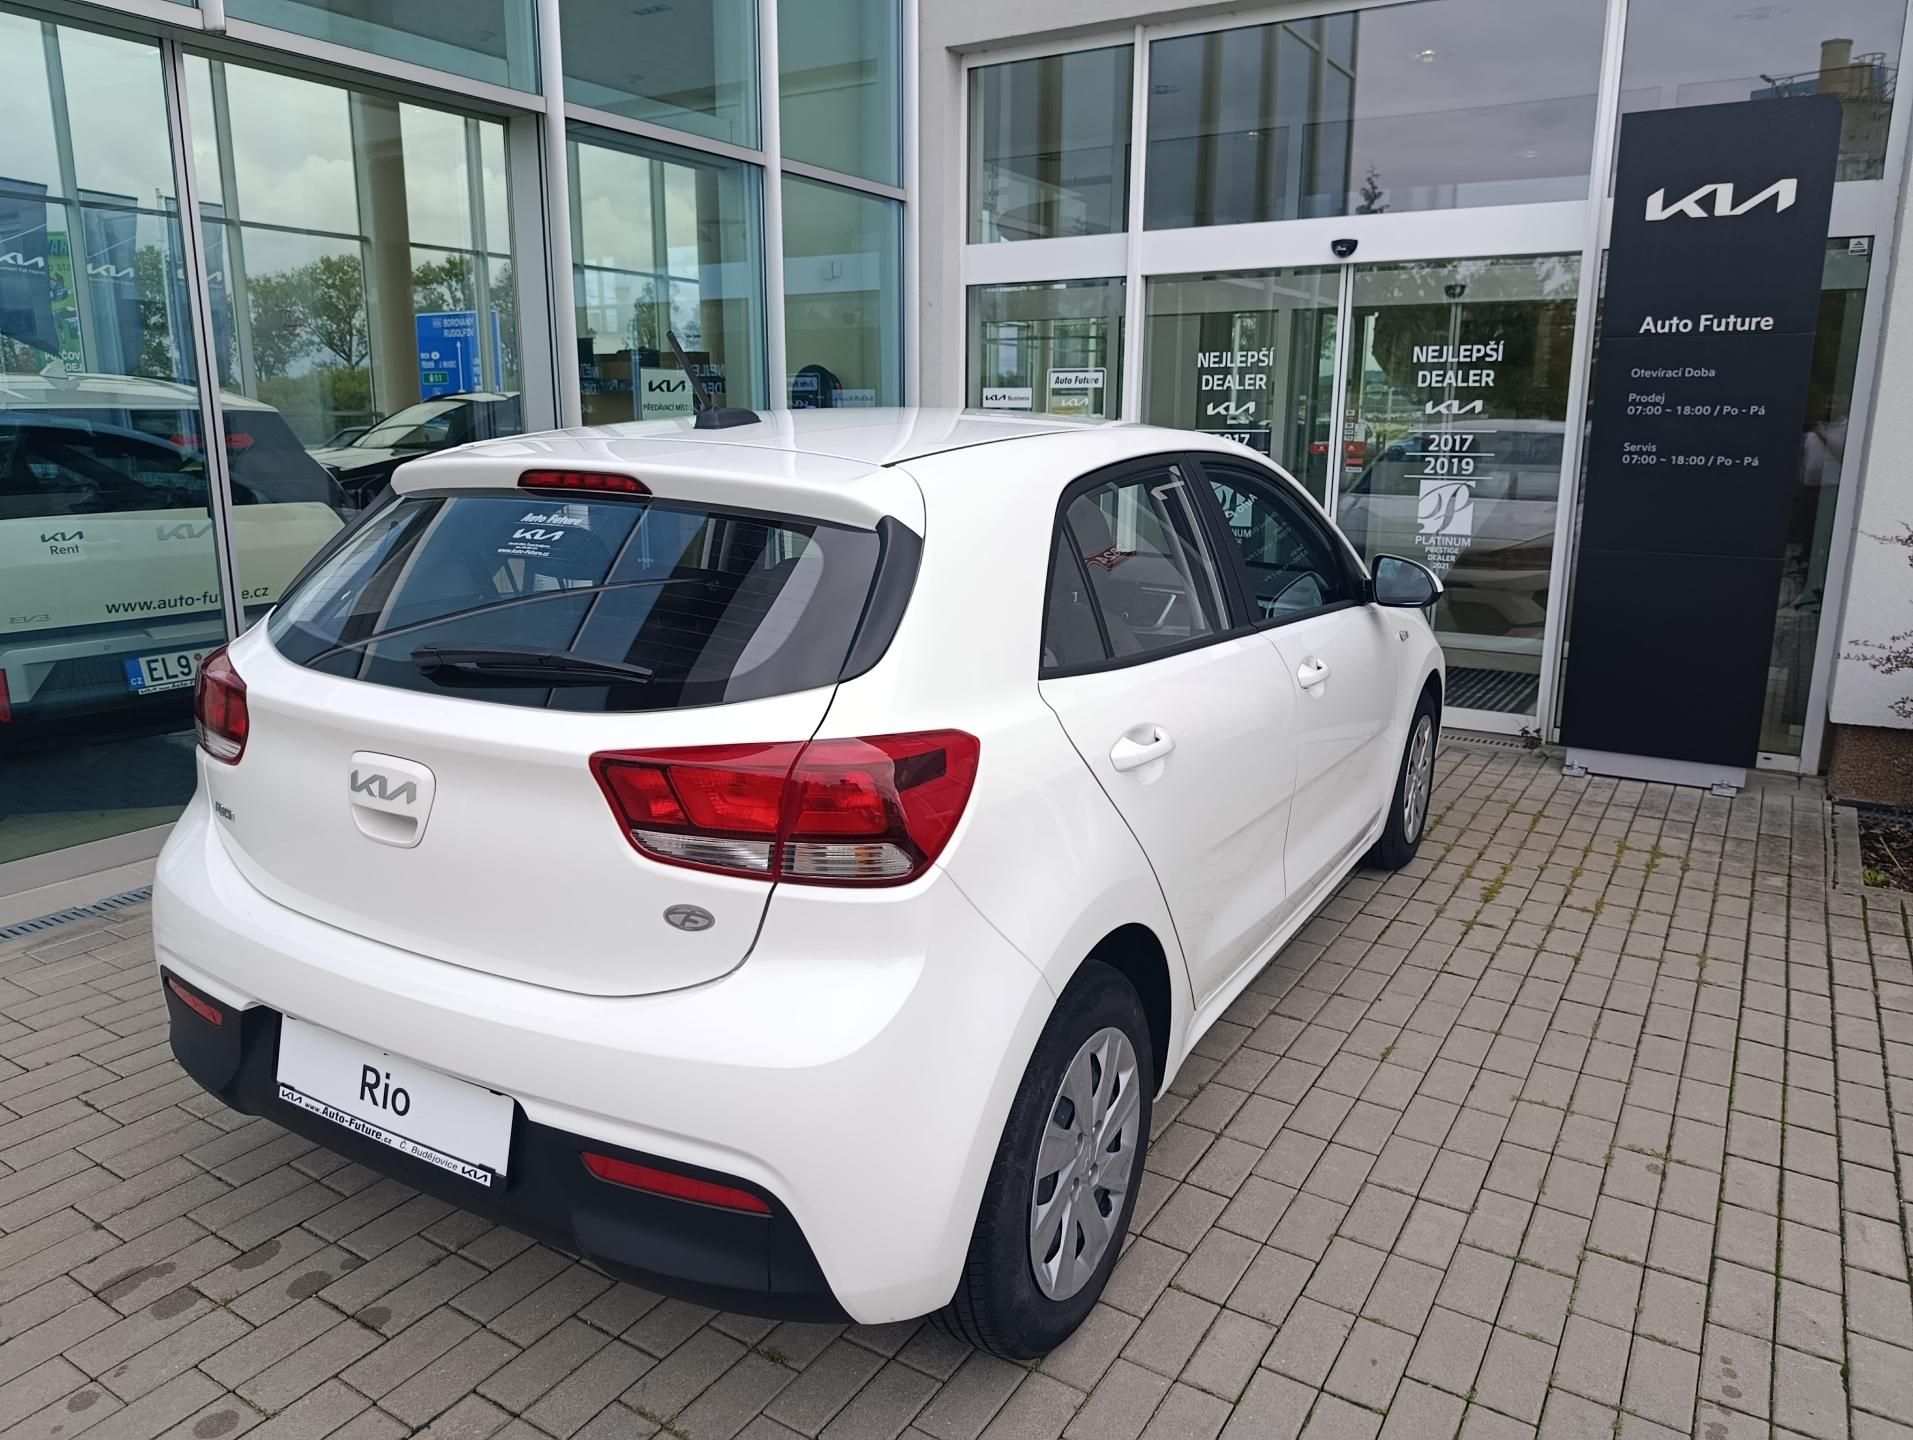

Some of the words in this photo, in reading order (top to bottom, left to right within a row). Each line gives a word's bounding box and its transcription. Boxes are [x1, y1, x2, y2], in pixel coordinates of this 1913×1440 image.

[1645, 178, 1797, 221] KIA
[1639, 316, 1693, 334] Auto
[1699, 314, 1774, 332] Future
[1412, 340, 1504, 363] NEJLEPŠÍ
[1197, 347, 1275, 369] NEJLEPŠÍ
[1417, 369, 1495, 387] DEALER
[1631, 367, 1683, 379] Otevírací
[1685, 367, 1716, 378] Doba
[648, 379, 686, 393] KIA
[1054, 376, 1072, 385] Auto
[1074, 376, 1099, 385] Future
[1201, 373, 1267, 391] DEALER
[1628, 393, 1665, 405] Prodej
[643, 402, 675, 412] PŘEDÁVACÍ
[1207, 401, 1256, 416] KIA
[1425, 400, 1483, 415] KIA
[1627, 405, 1662, 416] 07:00
[1676, 405, 1711, 416] 18:00
[1722, 405, 1739, 416] Po
[1750, 404, 1765, 416] Pá
[1214, 433, 1250, 445] 17
[1428, 434, 1473, 451] 2017
[1624, 442, 1656, 452] Servis
[1424, 458, 1474, 475] 2019
[1622, 455, 1656, 465] 07:00
[1671, 455, 1705, 466] 18:00
[1717, 456, 1732, 466] Po
[1744, 455, 1759, 467] Pá
[520, 512, 547, 523] Auto
[40, 531, 84, 543] KIA
[1415, 535, 1471, 547] PLATINUM
[50, 544, 80, 556] Rent
[1425, 546, 1460, 554] PRESTIGE
[1427, 554, 1456, 562] DEALER
[130, 677, 143, 685] CZ
[351, 770, 417, 804] KIA
[359, 1064, 411, 1117] Rio
[304, 1100, 393, 1145] www.Auto-Future.cz
[411, 1145, 458, 1171] Budějovice
[461, 1165, 489, 1184] KIA
